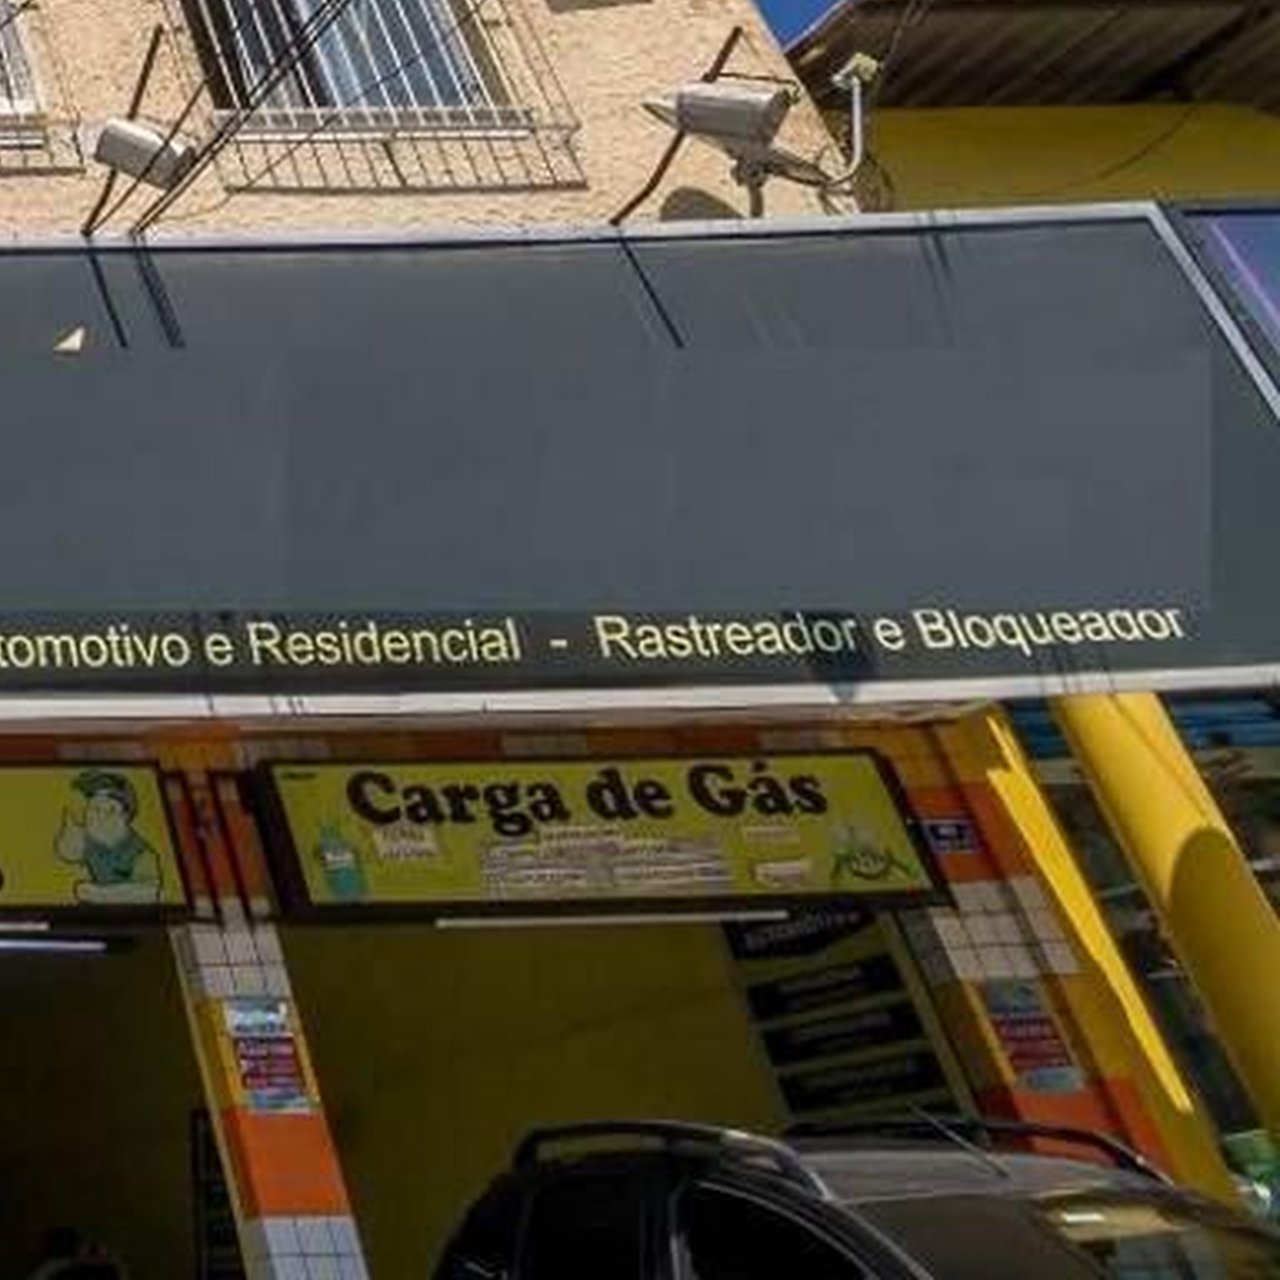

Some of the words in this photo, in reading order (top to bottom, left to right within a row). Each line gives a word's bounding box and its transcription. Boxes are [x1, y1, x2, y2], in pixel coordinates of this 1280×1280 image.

[204, 633, 234, 666] e
[246, 617, 521, 665] Residencial
[593, 613, 855, 660] Rastreador
[874, 619, 905, 648] e
[913, 608, 1185, 657] Bloqueador
[346, 770, 571, 837] Carga
[584, 766, 676, 819] de
[686, 760, 828, 818] Gás
